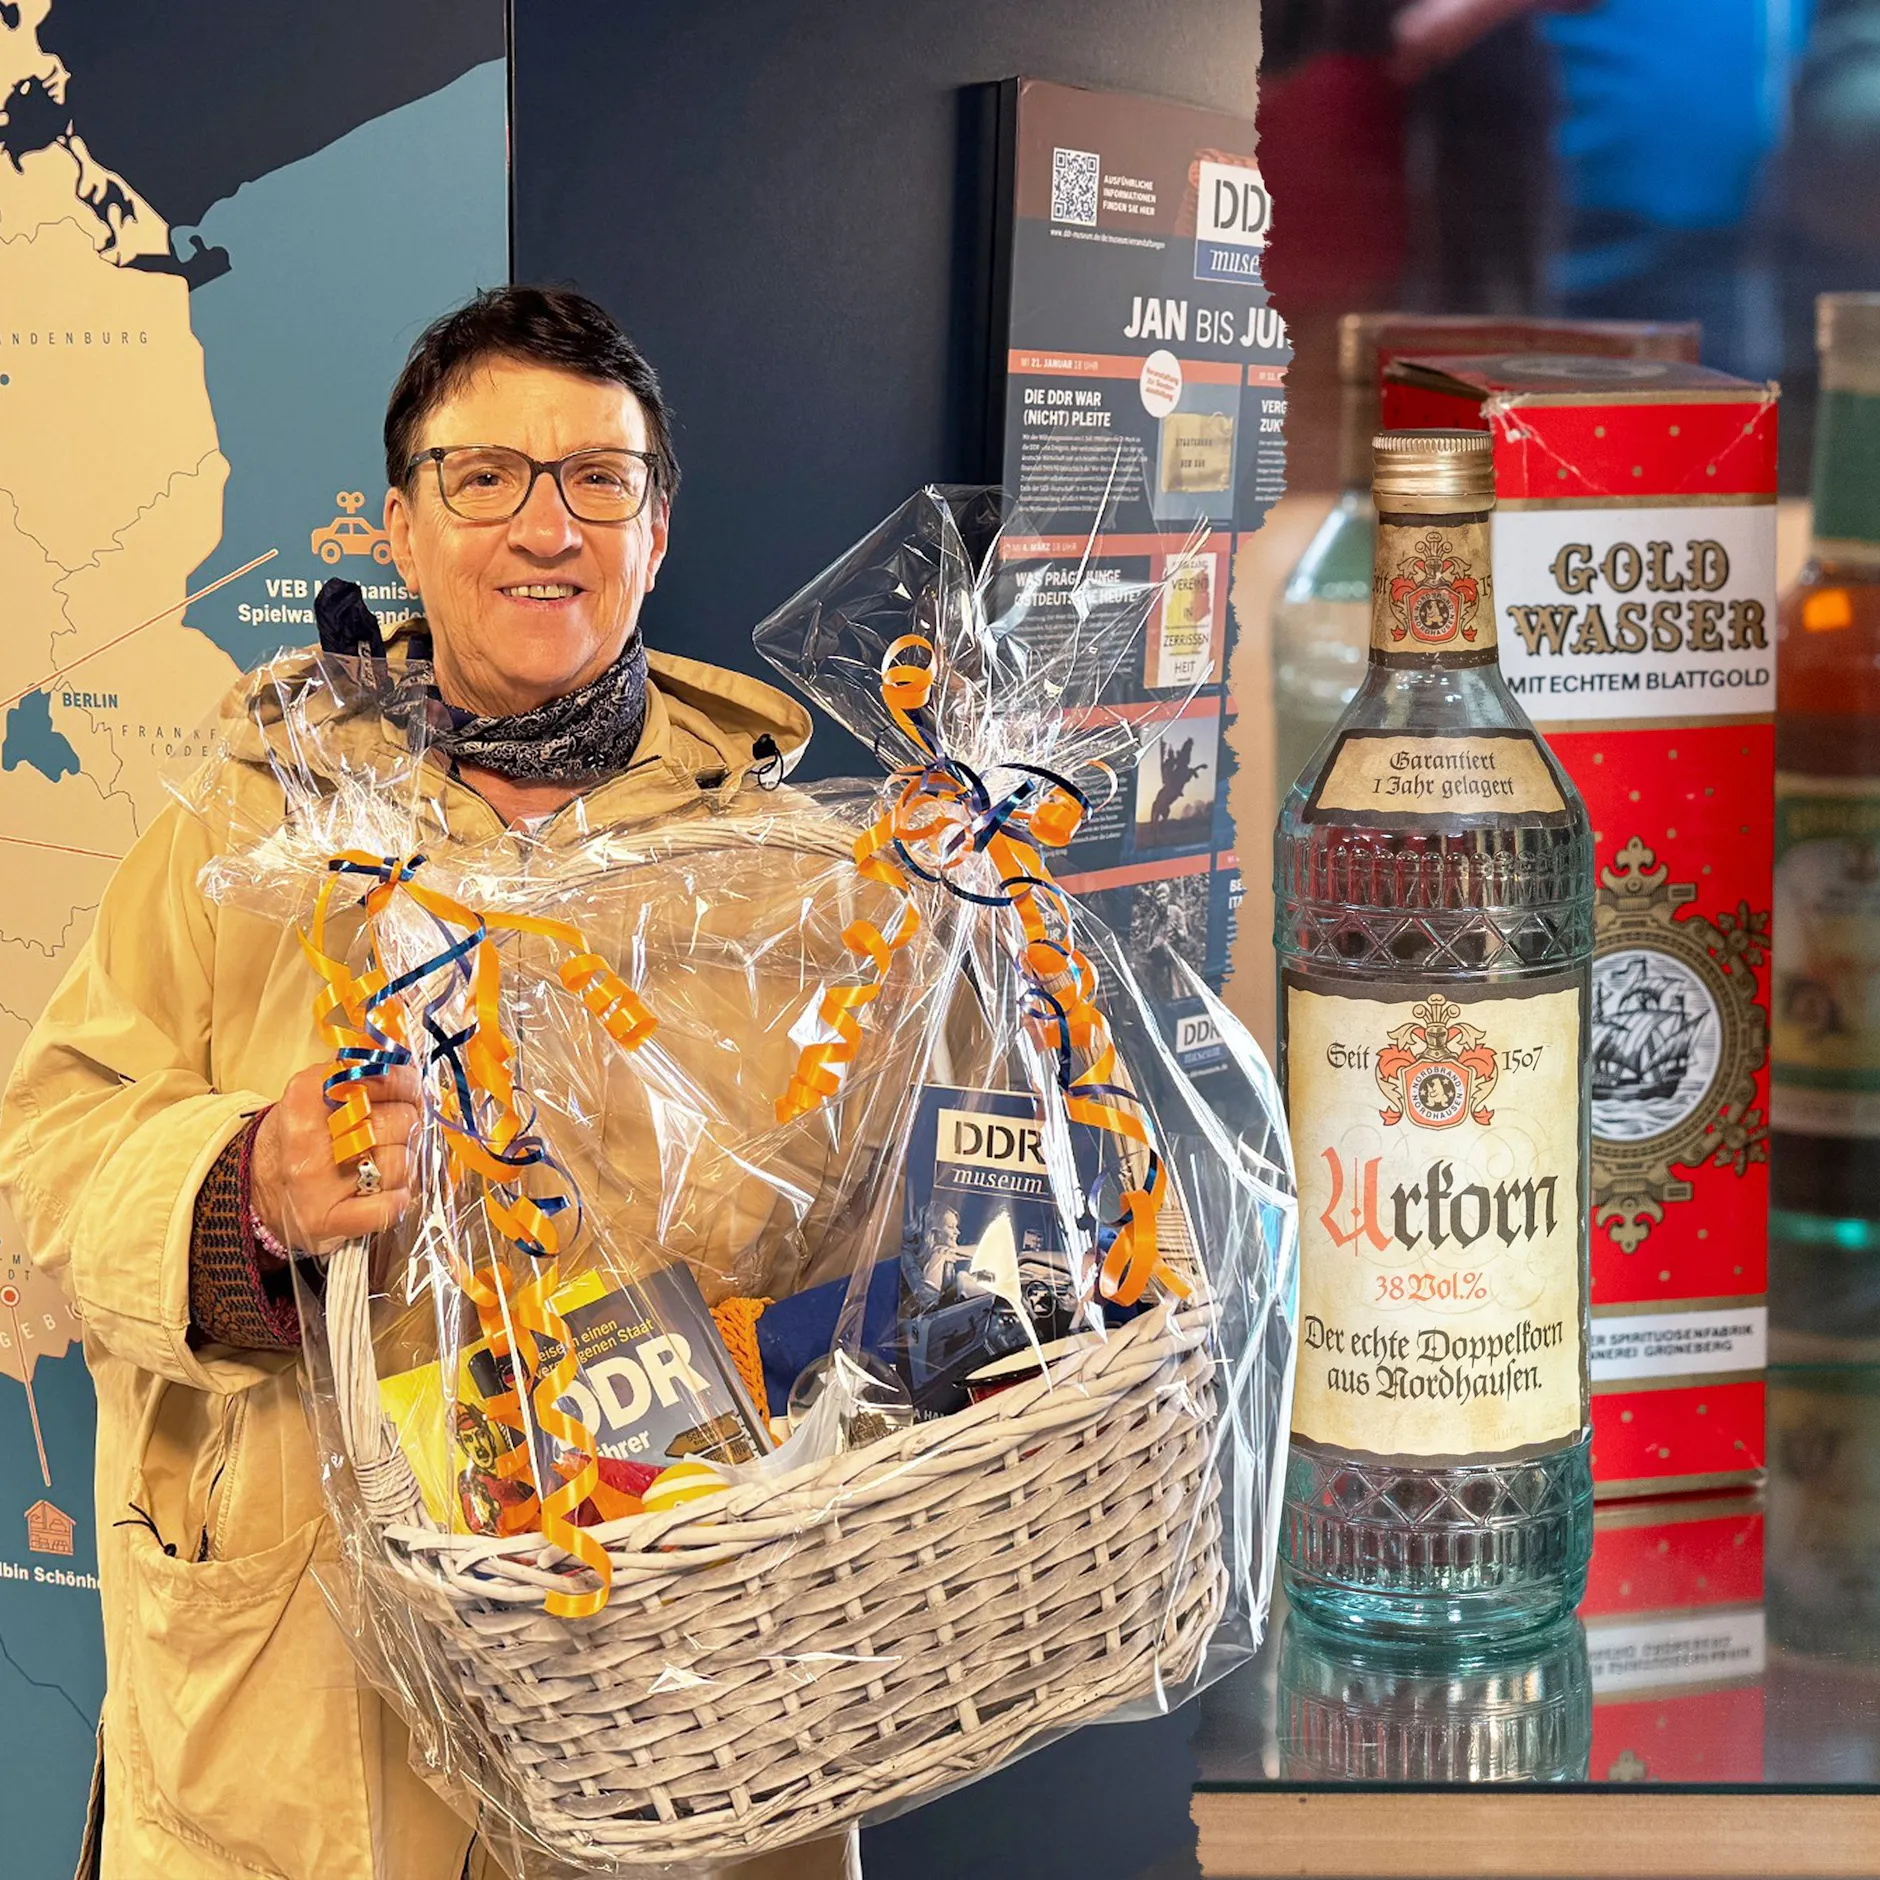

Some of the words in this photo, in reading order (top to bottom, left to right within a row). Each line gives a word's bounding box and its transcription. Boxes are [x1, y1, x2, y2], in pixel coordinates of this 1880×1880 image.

[1103, 188, 1157, 203] INFORMATIONEN
[1213, 179, 1274, 233] DD
[1102, 201, 1127, 213] FINDEN
[1210, 249, 1262, 276] muse
[1123, 297, 1188, 341] JAN
[1196, 309, 1234, 345] BIS
[0, 331, 148, 345] NDENBURG
[1043, 358, 1073, 370] JANUAR
[1024, 388, 1046, 404] DIE
[1048, 390, 1073, 406] DDR
[1075, 391, 1102, 407] WAR
[1261, 399, 1287, 414] VERG
[1023, 410, 1070, 426] (NICHT)
[1072, 411, 1112, 427] PLEITE
[1259, 418, 1284, 433] ZUK
[1030, 541, 1050, 551] MÄRZ
[1045, 568, 1080, 586] PRÄG
[1549, 540, 1730, 595] GOLD
[265, 579, 308, 598] VEB
[238, 604, 316, 626] Spielwa
[1414, 613, 1455, 637] NORDHAUSEN
[1506, 599, 1768, 656] WASSER
[1174, 660, 1196, 674] HEIT
[1508, 676, 1545, 694] MIT
[1550, 672, 1640, 693] ECHTEM
[1646, 668, 1770, 690] BLATTGOLD
[63, 693, 119, 708] BERLIN
[121, 725, 217, 740] FRANKF
[151, 744, 209, 757] (ODE
[1389, 750, 1496, 771] Garantiert
[1386, 774, 1435, 799] Jahr
[1441, 774, 1515, 799] gelagert
[1326, 1041, 1369, 1070] Seit
[1502, 1046, 1544, 1074] 1507
[1412, 1066, 1462, 1091] NORDBRAND
[1412, 1093, 1463, 1119] NORDHAUSEN
[954, 1121, 1046, 1164] DDR
[951, 1168, 1048, 1195] museum
[1320, 1147, 1559, 1257] Urkorn
[538, 1342, 567, 1362] eise
[580, 1320, 618, 1344] einen
[619, 1318, 655, 1344] Staat
[1304, 1315, 1345, 1354] Der
[1351, 1325, 1410, 1366] echte
[1416, 1320, 1564, 1369] Doppelkorn
[1610, 1324, 1753, 1345] SPIRITUOSENFABRIK
[1644, 1340, 1733, 1357] GRONEBERG
[1328, 1365, 1370, 1396] aus
